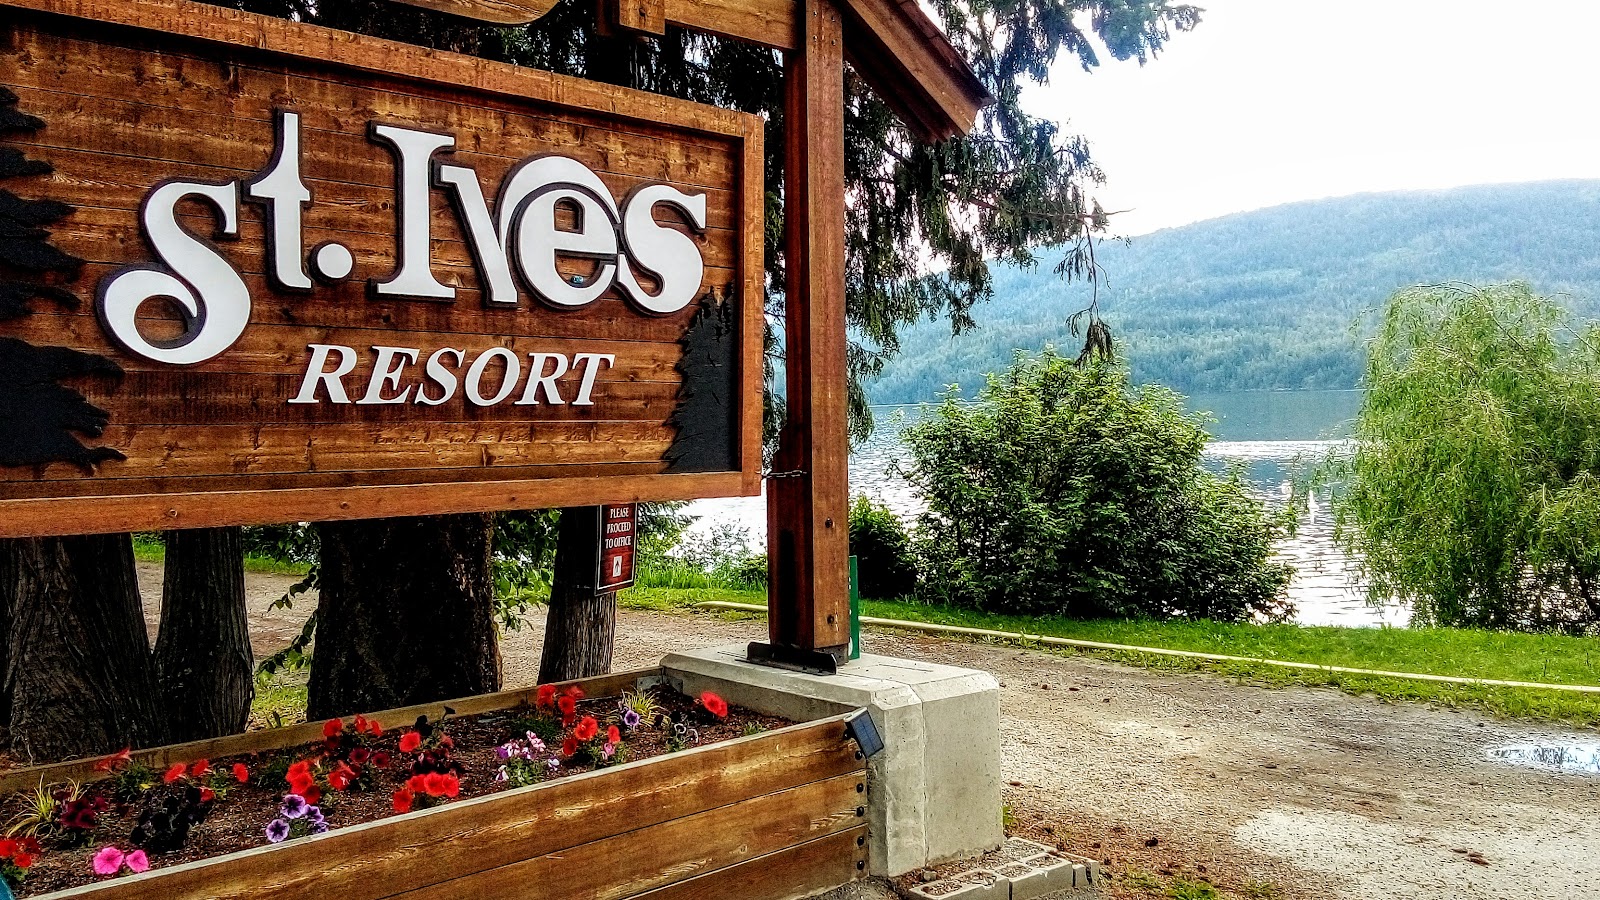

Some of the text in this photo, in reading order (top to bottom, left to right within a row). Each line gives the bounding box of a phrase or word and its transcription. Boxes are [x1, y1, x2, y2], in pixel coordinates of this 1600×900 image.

[375, 124, 706, 314] Ives
[287, 343, 616, 407] RESORT
[610, 507, 629, 519] PLEASE
[606, 521, 631, 534] PROCEED
[605, 536, 631, 549] TO OFFICE
